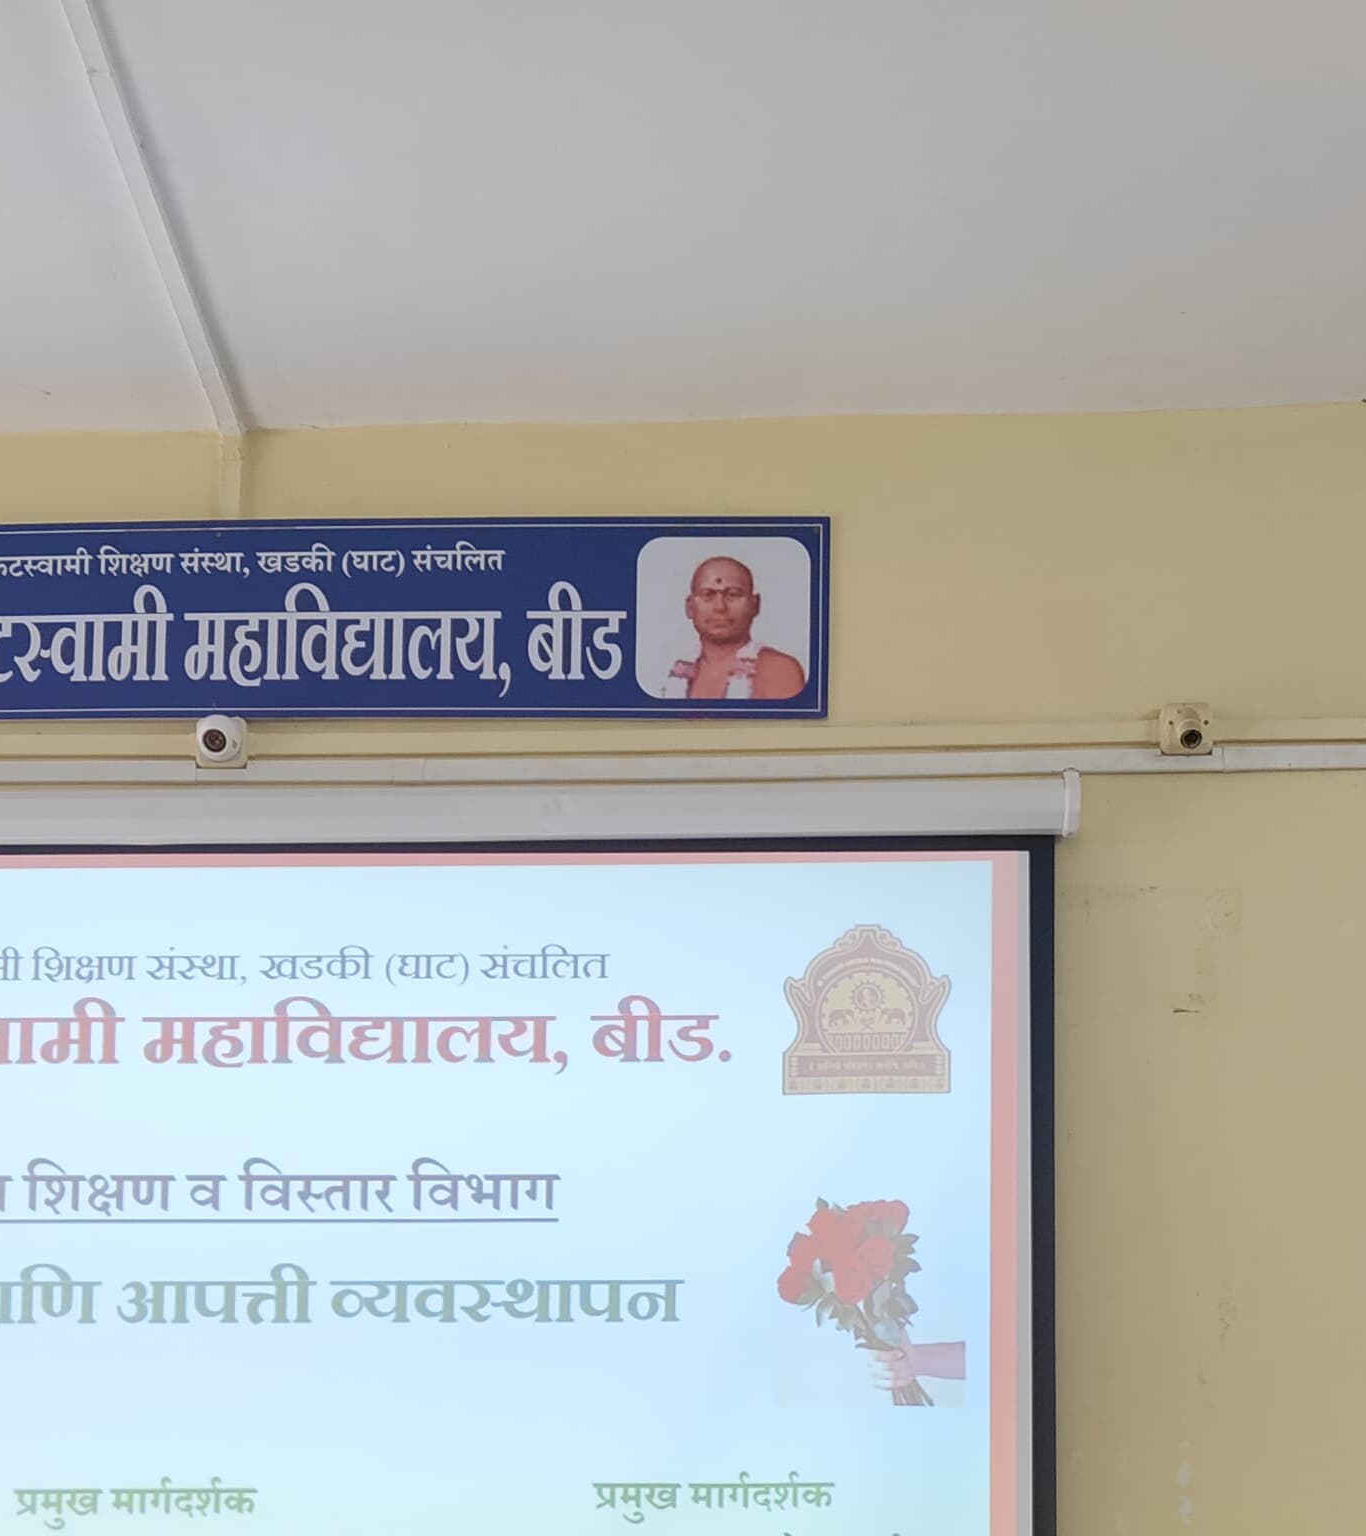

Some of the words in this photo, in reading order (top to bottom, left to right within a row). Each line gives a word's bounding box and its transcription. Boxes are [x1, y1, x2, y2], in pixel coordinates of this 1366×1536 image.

[96, 544, 176, 577] शिक्षण
[178, 547, 250, 578] संस्था,
[255, 542, 336, 574] खडकी
[341, 549, 405, 578] (घाट)
[410, 540, 506, 572] संचलित
[184, 583, 510, 697] महाविद्यालय,
[527, 581, 627, 679] बीड
[31, 945, 138, 984] शिक्षण
[146, 946, 247, 985] संस्था,
[258, 944, 375, 980] खडकी
[385, 953, 470, 985] (घाट)
[479, 943, 611, 980] संचलित
[142, 996, 567, 1075] महाविद्यालय,
[590, 995, 731, 1062] बीड.
[21, 1158, 176, 1216] शिक्षण
[186, 1175, 227, 1211] व
[238, 1157, 397, 1213] विस्तार
[406, 1157, 561, 1211] विभाग
[117, 1263, 317, 1325] आपत्ती
[330, 1276, 686, 1324] व्यवस्थापन
[14, 1489, 103, 1530] प्रमुख
[110, 1477, 258, 1517] मार्गदर्शक
[593, 1483, 681, 1524] प्रमुख
[688, 1471, 835, 1512] मार्गदर्शक
